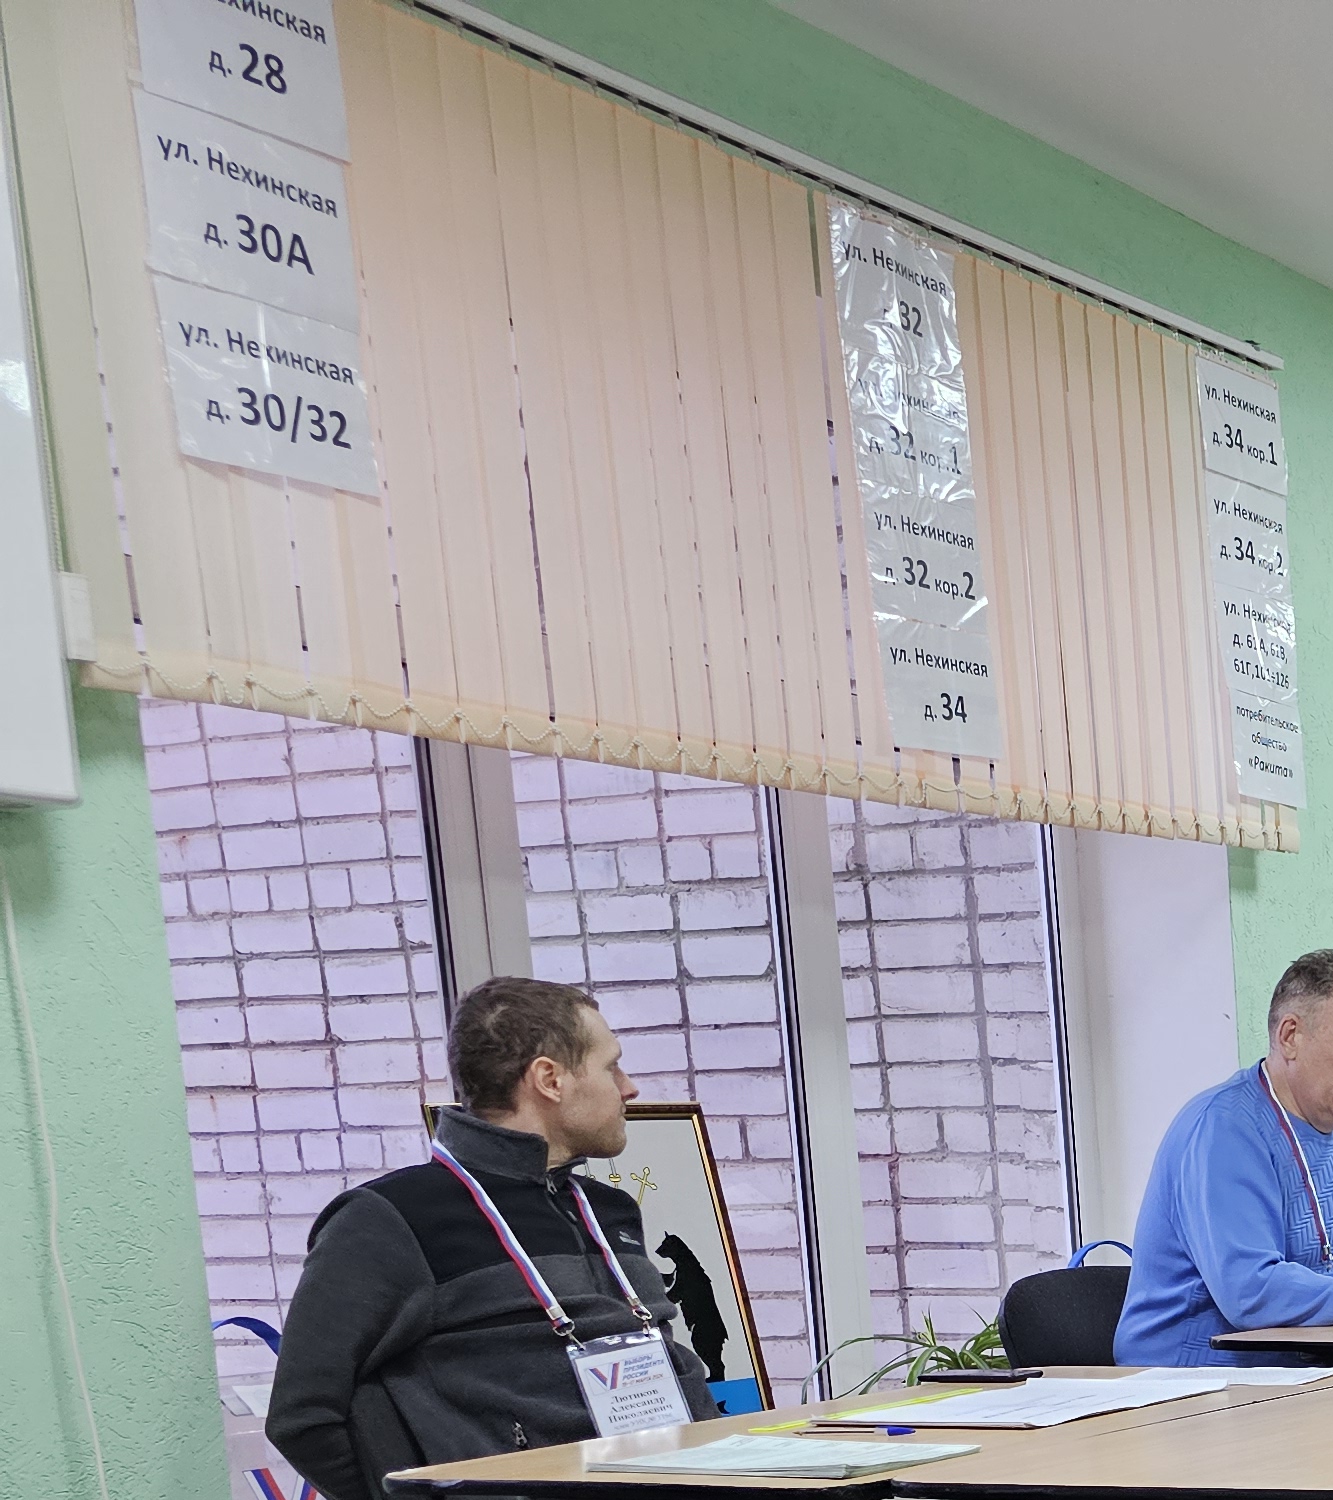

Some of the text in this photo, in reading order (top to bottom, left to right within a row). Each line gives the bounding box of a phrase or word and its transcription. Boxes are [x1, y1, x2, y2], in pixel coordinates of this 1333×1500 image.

[217, 0, 327, 45] хинская
[208, 43, 288, 95] д. 28
[156, 134, 339, 219] ул. Нехинская
[203, 213, 316, 277] д. 30А
[842, 240, 948, 297] ул. Нехинская
[898, 300, 924, 338] 32
[178, 321, 355, 386] ул. Нехинская
[206, 387, 353, 450] д. 30/32
[1204, 383, 1277, 424] ул. Нехинская
[886, 424, 917, 462] 32
[1212, 423, 1278, 466] д. 34 кор.1
[874, 511, 975, 551] ул. Нехинская
[1213, 498, 1284, 535] ул. Нехинская
[1220, 544, 1231, 561] д.
[1233, 536, 1256, 565] 34
[902, 556, 931, 590] 32
[934, 571, 976, 601] кор.2
[1223, 600, 1240, 616] ул.
[1232, 633, 1244, 649] д.
[890, 645, 989, 678] ул. Нехинская
[924, 692, 968, 723] д. 34
[1236, 705, 1299, 734] потребительское
[1251, 732, 1288, 753] общество
[1248, 755, 1294, 778] «Ракита»
[622, 1370, 649, 1380] РОССИИ
[623, 1359, 665, 1373] ПРЕЗИДЕНТА
[608, 1404, 673, 1424] Николаевич
[610, 1388, 659, 1404] Лютиков
[610, 1396, 666, 1414] Александр
